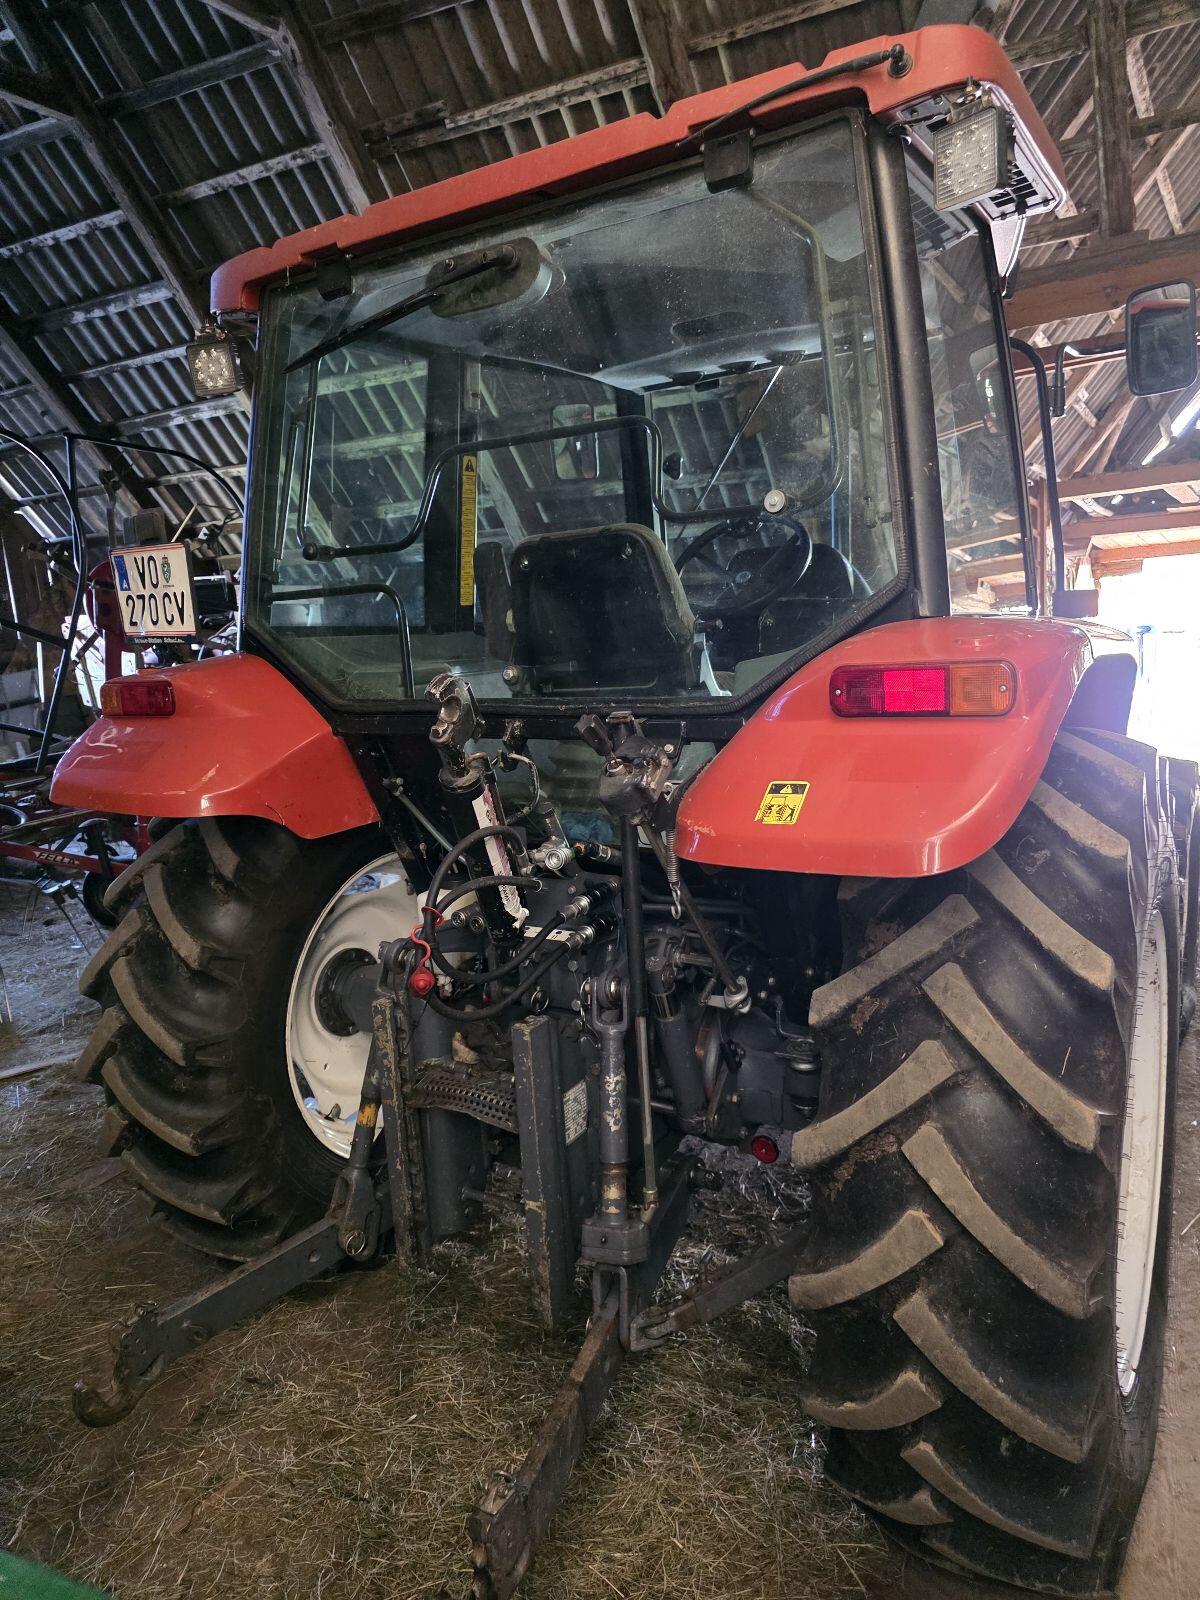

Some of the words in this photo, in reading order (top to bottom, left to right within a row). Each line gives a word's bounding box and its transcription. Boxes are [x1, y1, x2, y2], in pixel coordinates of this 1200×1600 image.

[133, 555, 159, 590] VO
[122, 580, 129, 589] A
[37, 851, 75, 865] FELLA
